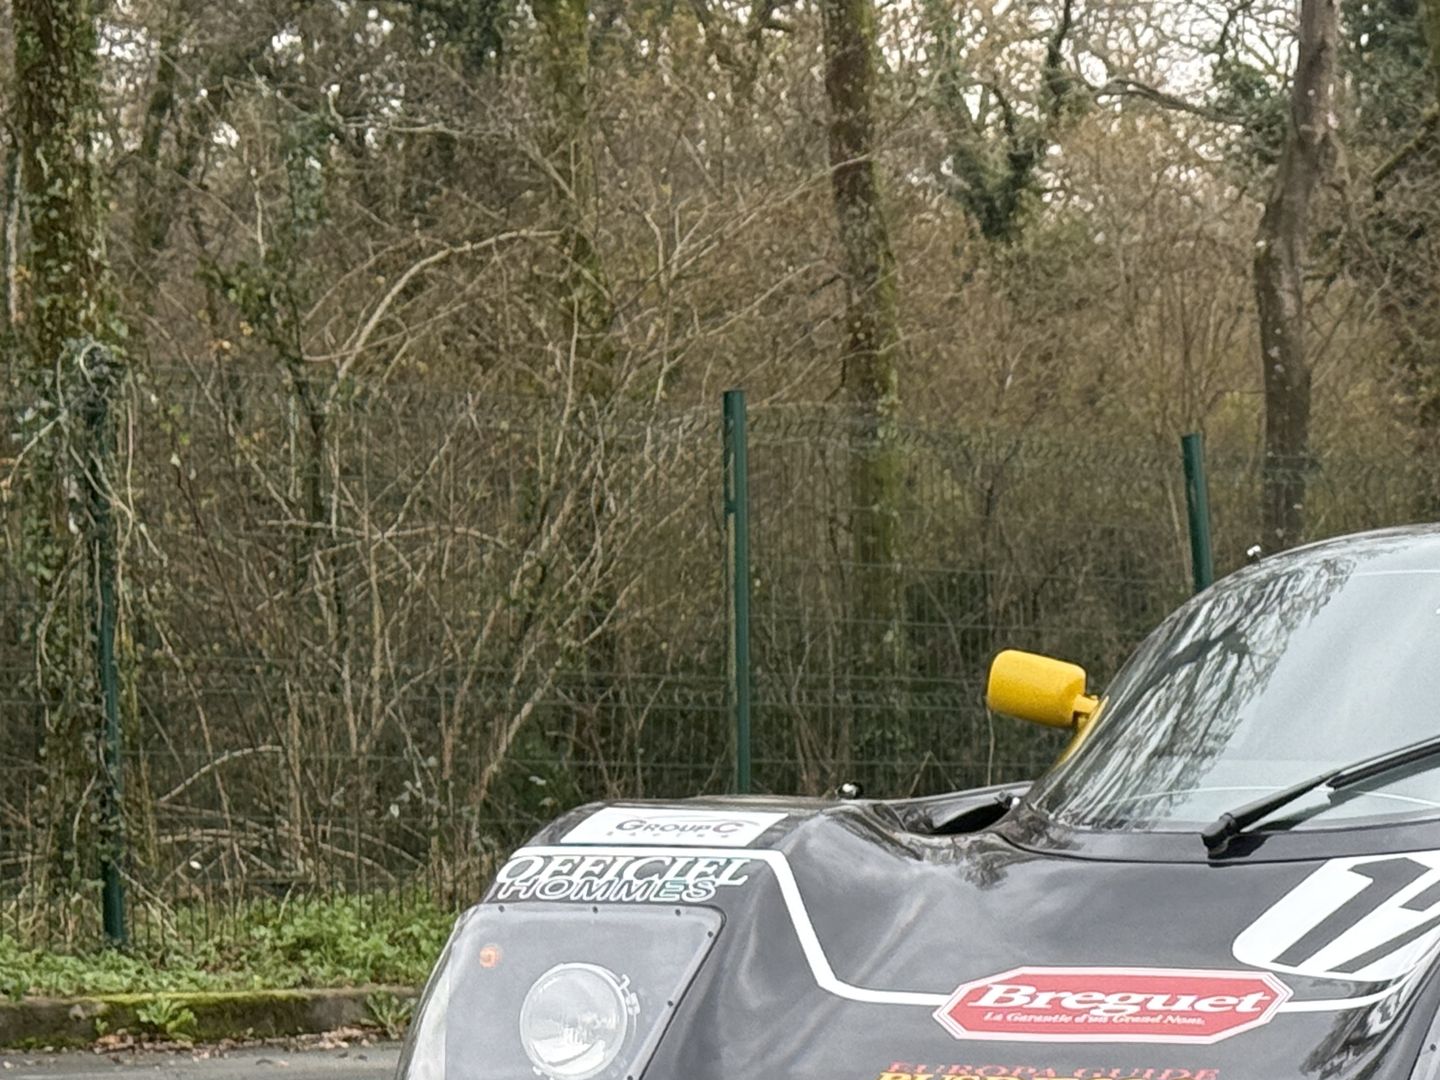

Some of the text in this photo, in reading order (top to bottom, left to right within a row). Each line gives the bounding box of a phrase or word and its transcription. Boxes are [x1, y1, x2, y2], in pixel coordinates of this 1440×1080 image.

[495, 856, 751, 887] OFFICIEL
[497, 878, 717, 902] HOMMES
[968, 983, 1271, 1017] Breguet
